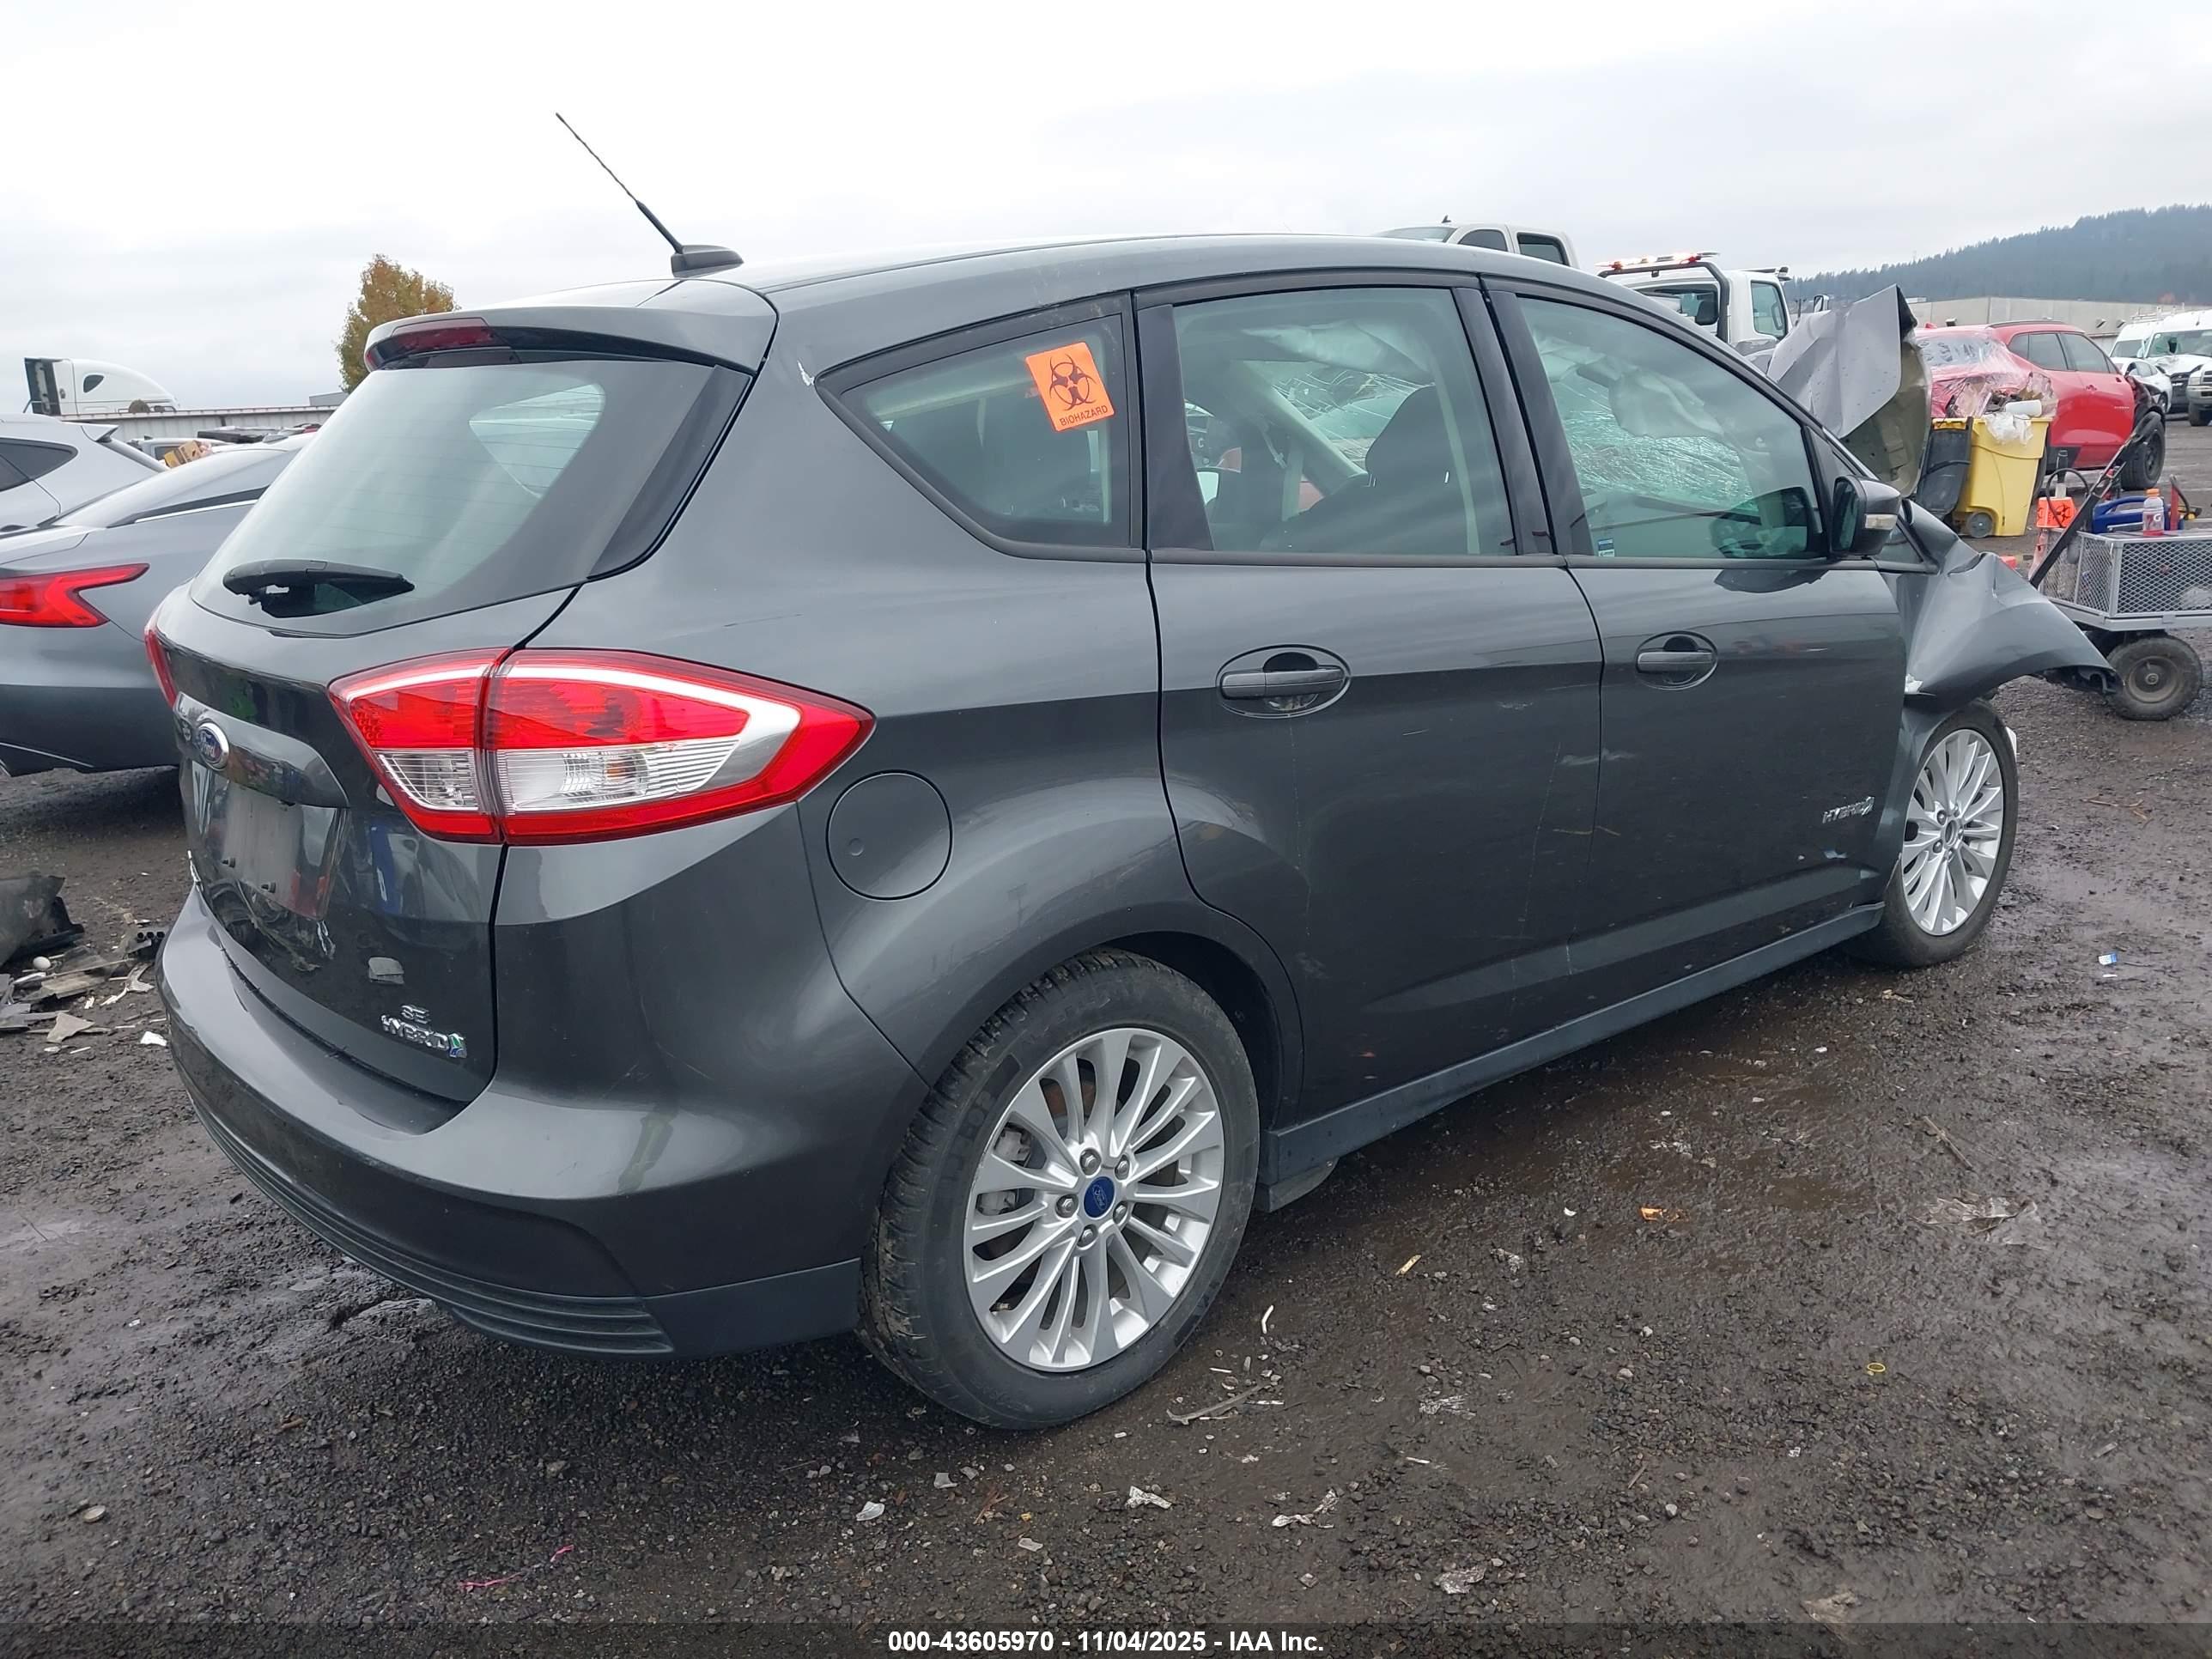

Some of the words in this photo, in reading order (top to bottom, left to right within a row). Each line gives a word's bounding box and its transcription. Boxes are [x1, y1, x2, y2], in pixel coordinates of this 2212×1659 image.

[1059, 404, 1109, 427] BIOHAZARD
[401, 1005, 431, 1024] SE
[380, 1014, 450, 1051] HYBRID
